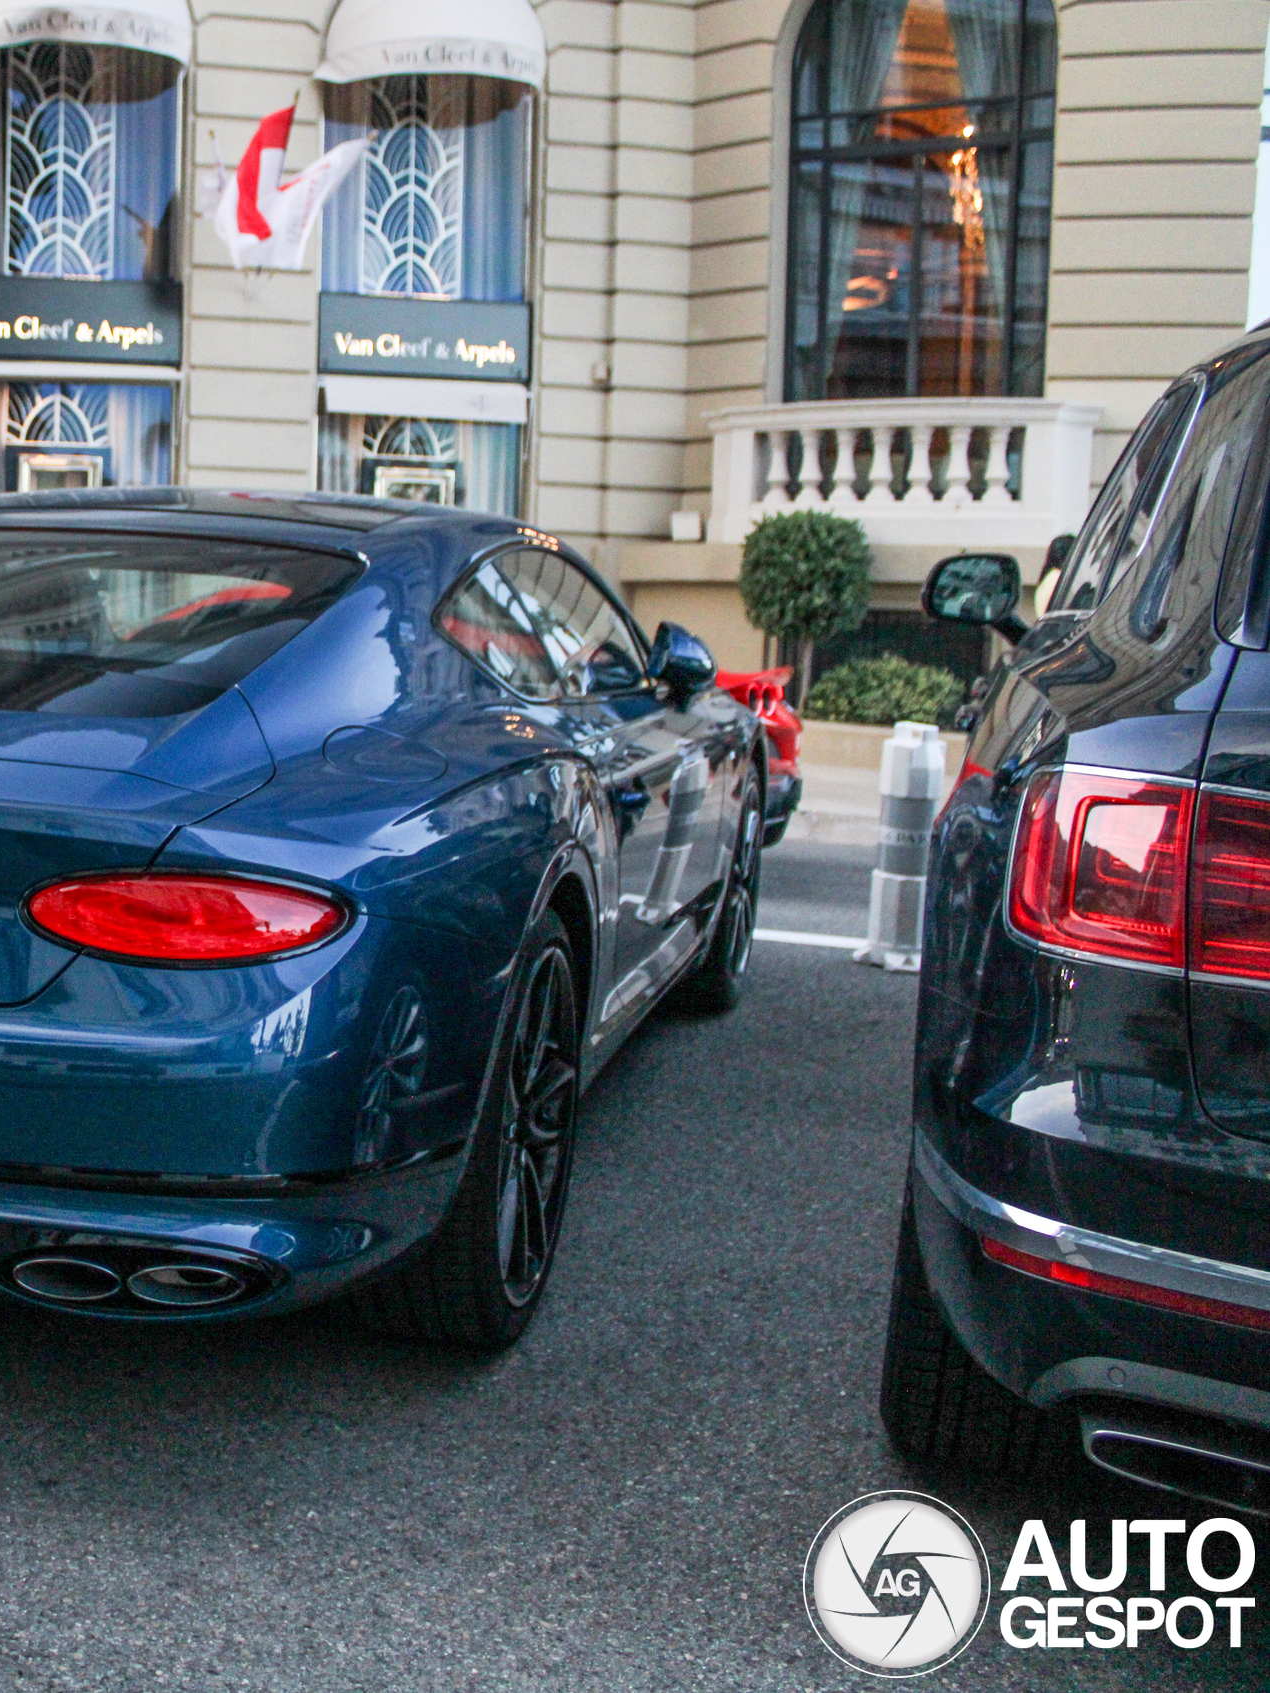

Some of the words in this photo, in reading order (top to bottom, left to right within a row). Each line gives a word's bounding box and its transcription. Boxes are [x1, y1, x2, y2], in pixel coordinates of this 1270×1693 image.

[14, 315, 74, 340] Cleef
[75, 322, 94, 343] &
[96, 319, 163, 350] Arpels
[334, 332, 375, 357] Van
[376, 333, 432, 358] Cleef
[434, 342, 449, 360] &
[454, 338, 516, 368] Arpels
